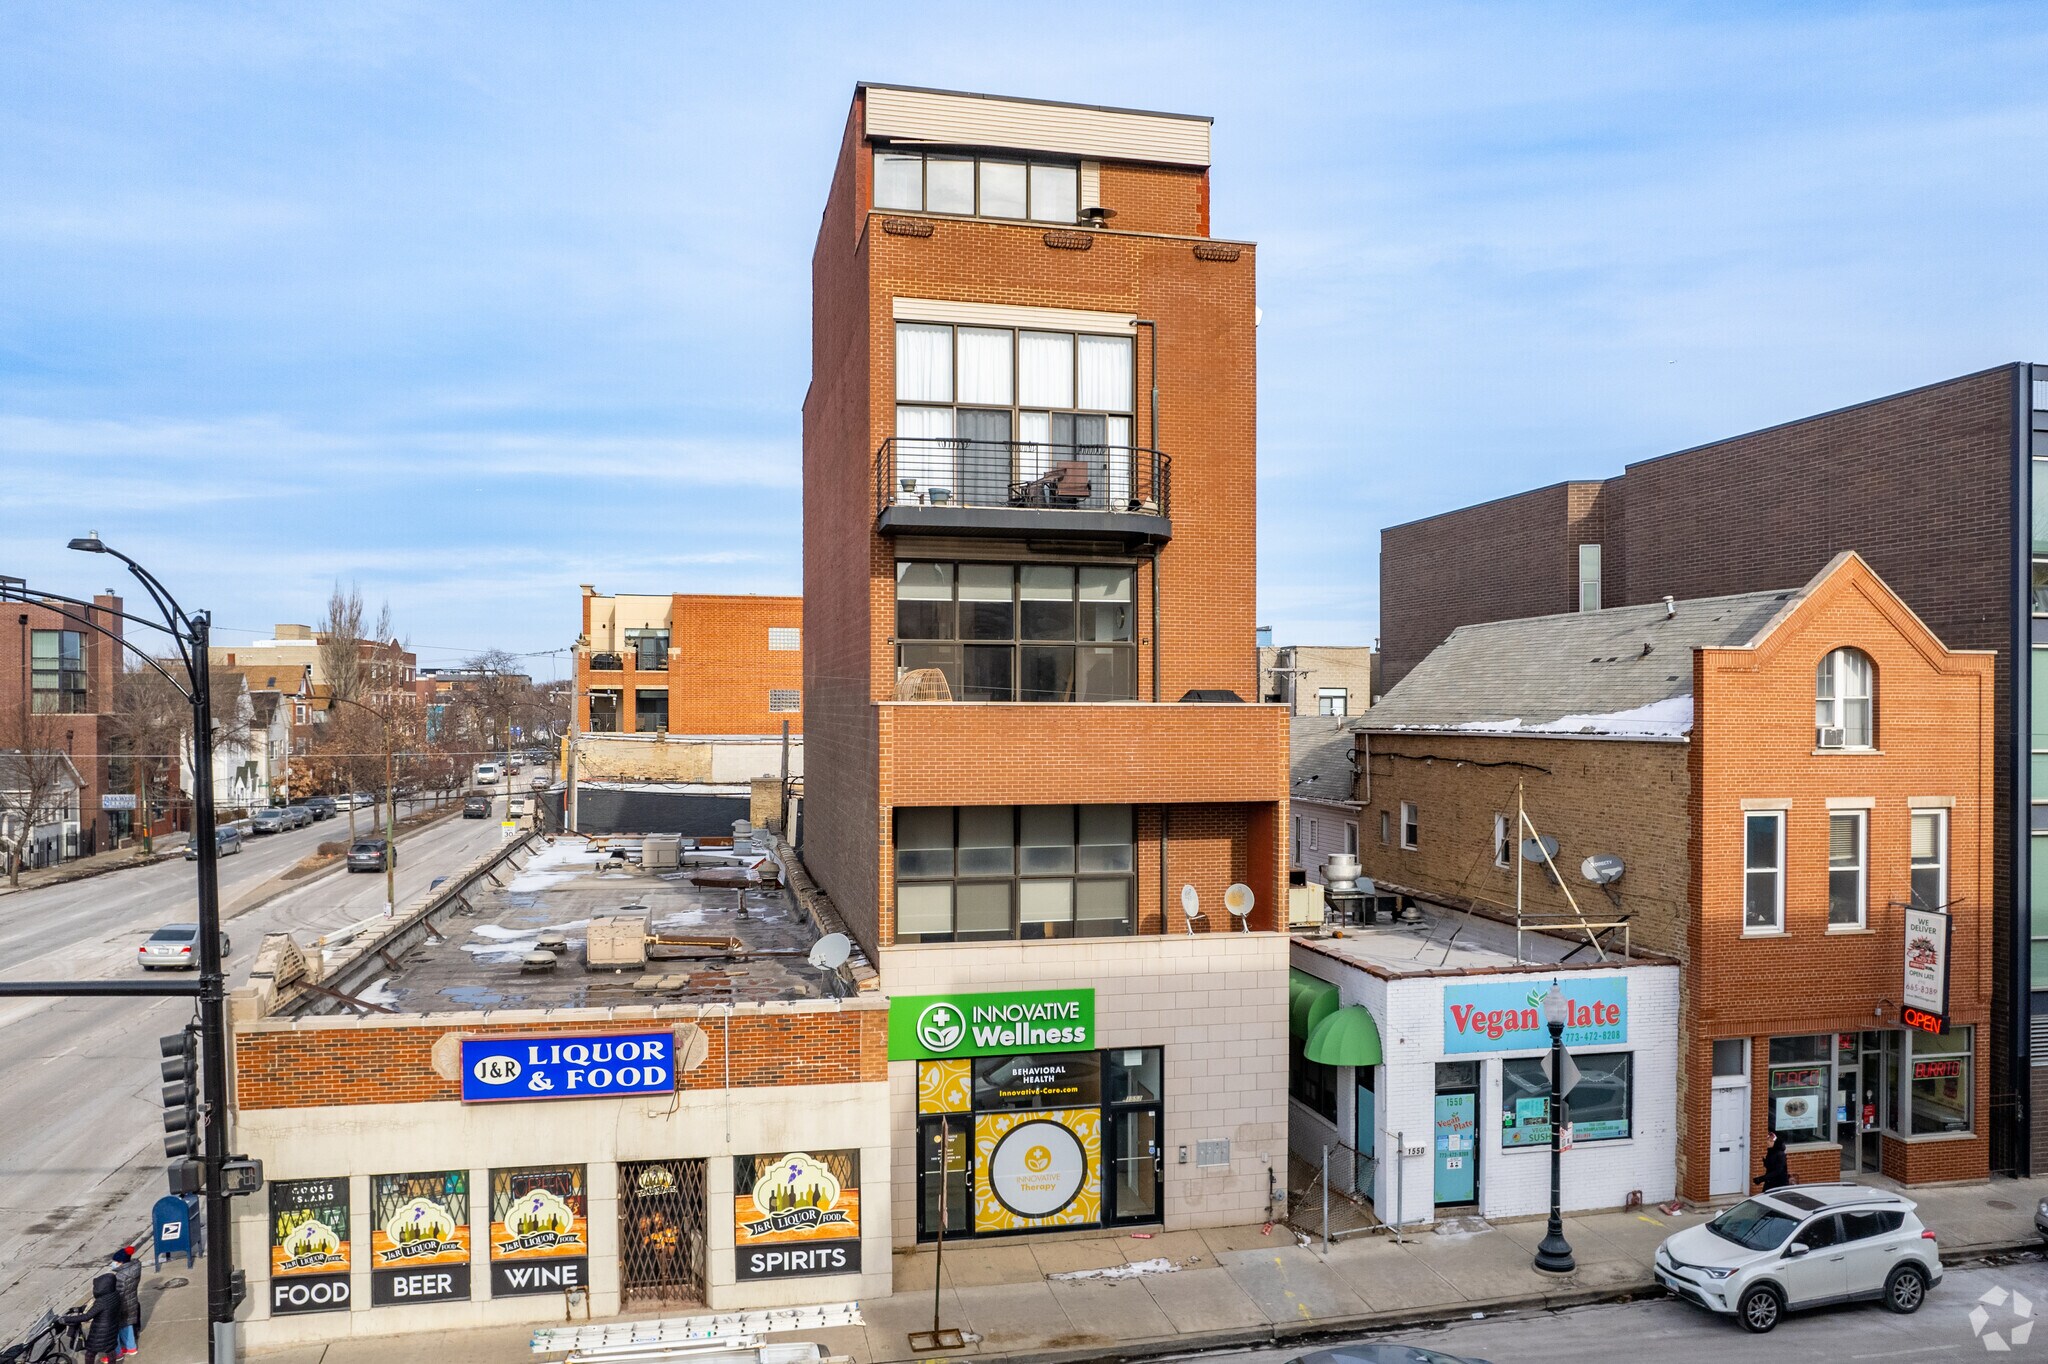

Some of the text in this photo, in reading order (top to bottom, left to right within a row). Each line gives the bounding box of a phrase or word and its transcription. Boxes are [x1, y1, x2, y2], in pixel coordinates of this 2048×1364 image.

[1910, 924, 1937, 935] DELIVER
[1918, 918, 1929, 926] WE
[1909, 970, 1923, 978] OPEN
[973, 1001, 1080, 1024] INNOVATIVE
[1450, 999, 1621, 1040] Vegan late
[1905, 1009, 1942, 1035] OPEN
[971, 1022, 1086, 1048] Wellness
[1565, 1031, 1620, 1042] 773-472-8208
[527, 1040, 666, 1067] LIQUOR
[1012, 1066, 1066, 1076] BEHAVIORAL
[1775, 1070, 1819, 1086] TACO
[1915, 1061, 1960, 1078] BURRITO
[527, 1066, 667, 1091] & FOOD
[1023, 1075, 1055, 1084] HEALTH
[999, 1087, 1078, 1097] Innovative-Care.com
[1446, 1097, 1463, 1106] 1550
[1437, 1116, 1460, 1128] Vegan
[1453, 1120, 1473, 1131] Plate
[1408, 1147, 1425, 1155] 1550
[514, 1175, 569, 1198] OPEN
[1016, 1173, 1061, 1183] INNOVATIVE
[753, 1209, 842, 1235] J&R LIQUOR FOOD
[387, 1240, 457, 1261] J&R LIQUOR FOOD
[505, 1232, 575, 1252] J&R LIQUOR FOOD
[300, 1254, 325, 1265] LIQUOR
[750, 1248, 847, 1273] SPIRITS
[393, 1273, 452, 1297] BEER
[504, 1265, 578, 1288] WINE
[275, 1282, 349, 1307] FOOD
